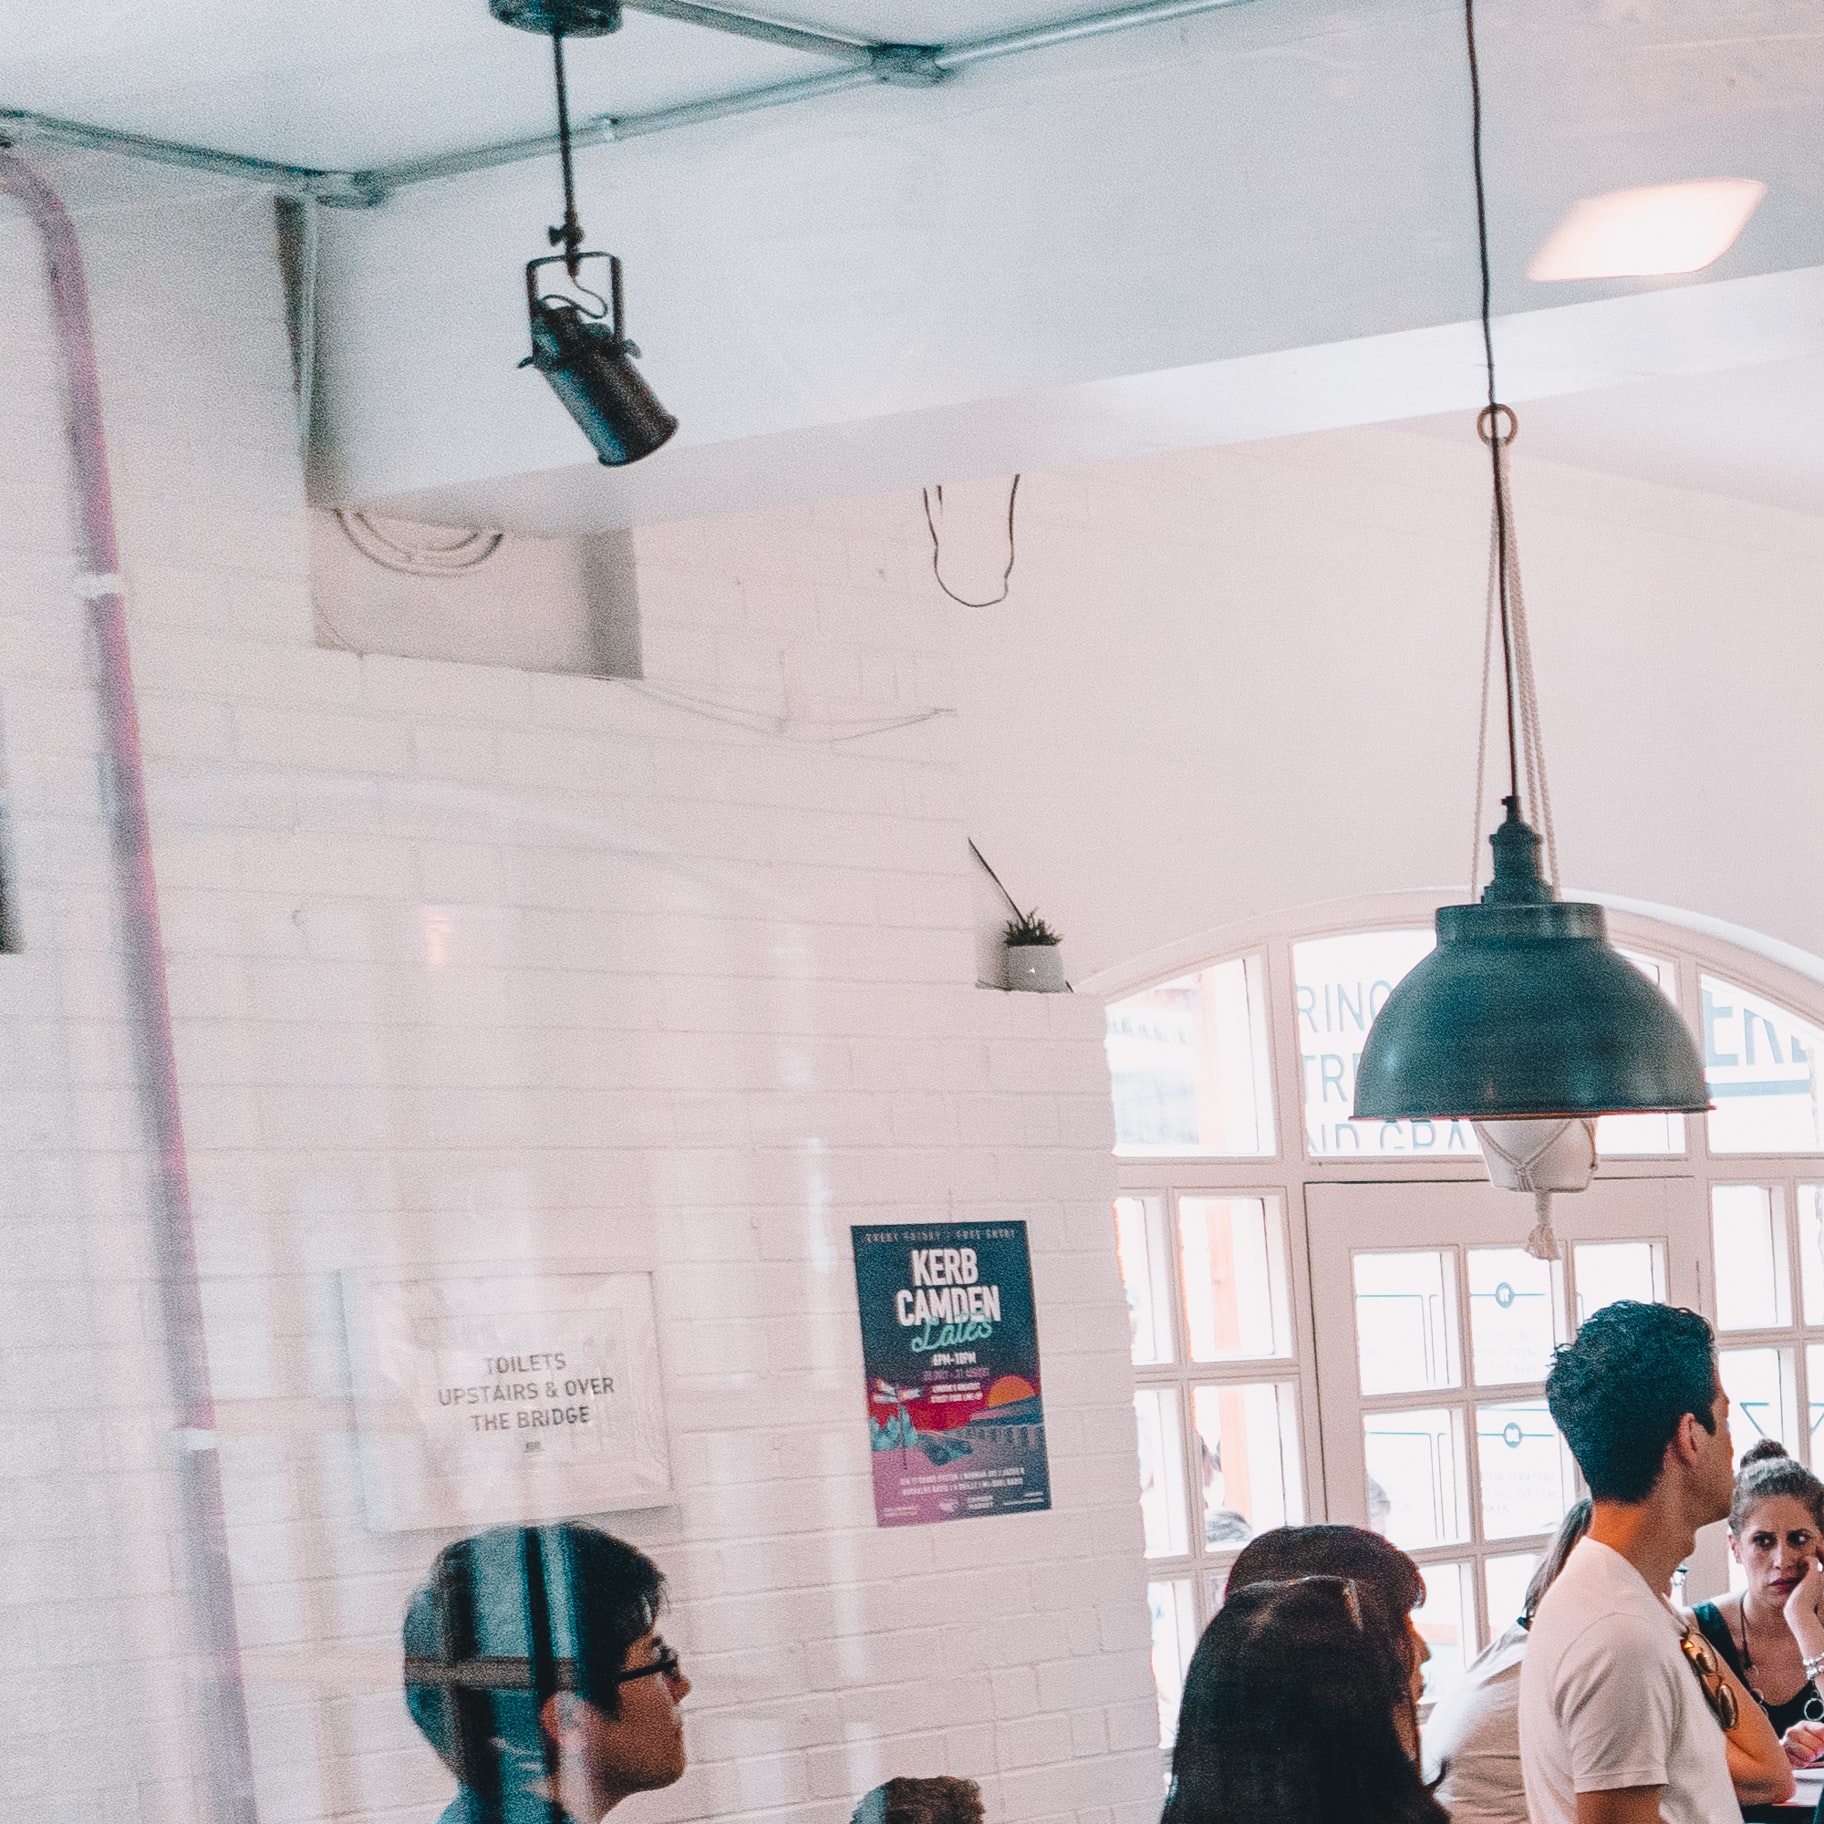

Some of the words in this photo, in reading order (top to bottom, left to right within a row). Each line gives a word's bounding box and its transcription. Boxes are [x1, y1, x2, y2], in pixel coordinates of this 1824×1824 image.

[911, 1248, 979, 1287] KERB
[896, 1285, 1002, 1327] CAMDEN
[911, 1310, 993, 1353] Lates
[486, 1352, 567, 1375] TOILETS
[437, 1379, 539, 1407] UPSTAIRS
[545, 1380, 559, 1398] &
[564, 1377, 616, 1397] OVER
[470, 1412, 510, 1433] THE
[517, 1406, 592, 1430] BRIDGE
